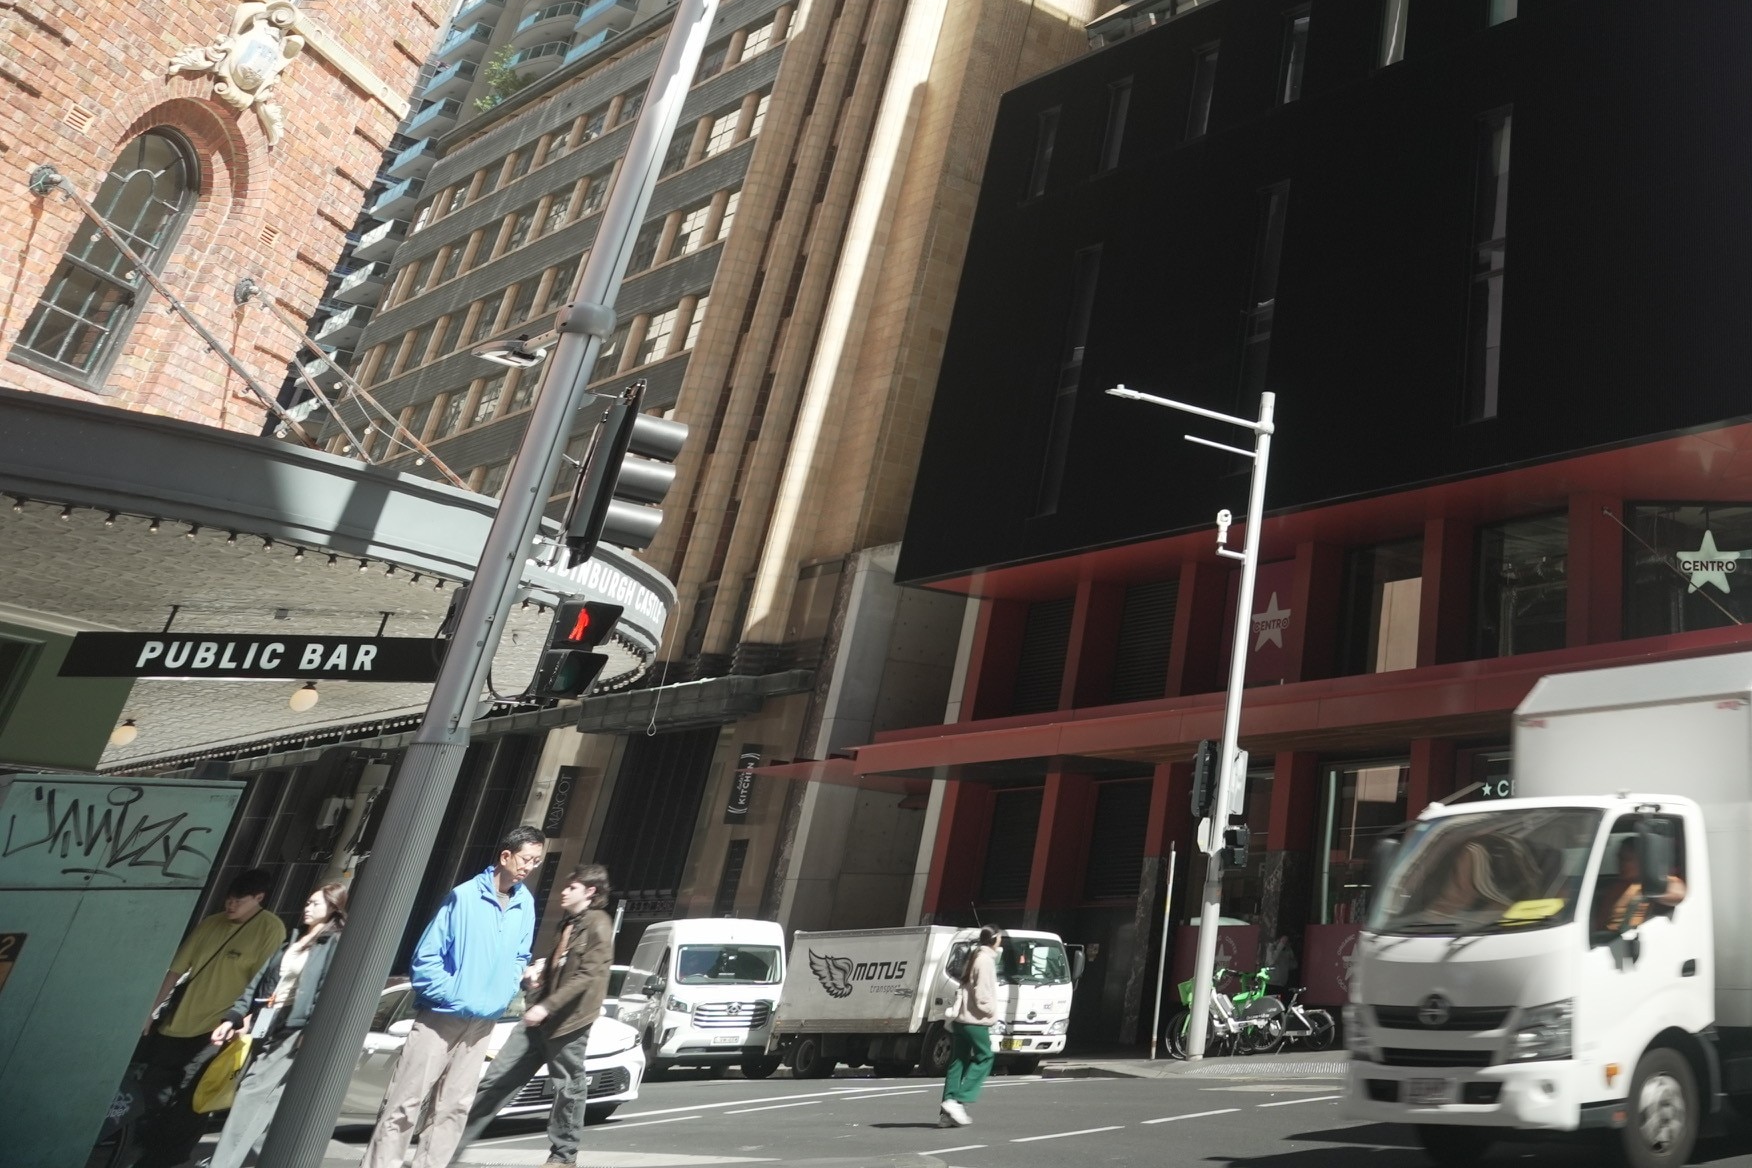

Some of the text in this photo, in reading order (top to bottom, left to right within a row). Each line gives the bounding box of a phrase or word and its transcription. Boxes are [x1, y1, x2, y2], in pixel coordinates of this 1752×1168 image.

[1682, 560, 1736, 572] CENTRO
[635, 586, 664, 624] CASTLE
[1253, 618, 1289, 632] CENTRO
[135, 641, 378, 671] PUBLIC BAR
[852, 961, 907, 981] MOTUS
